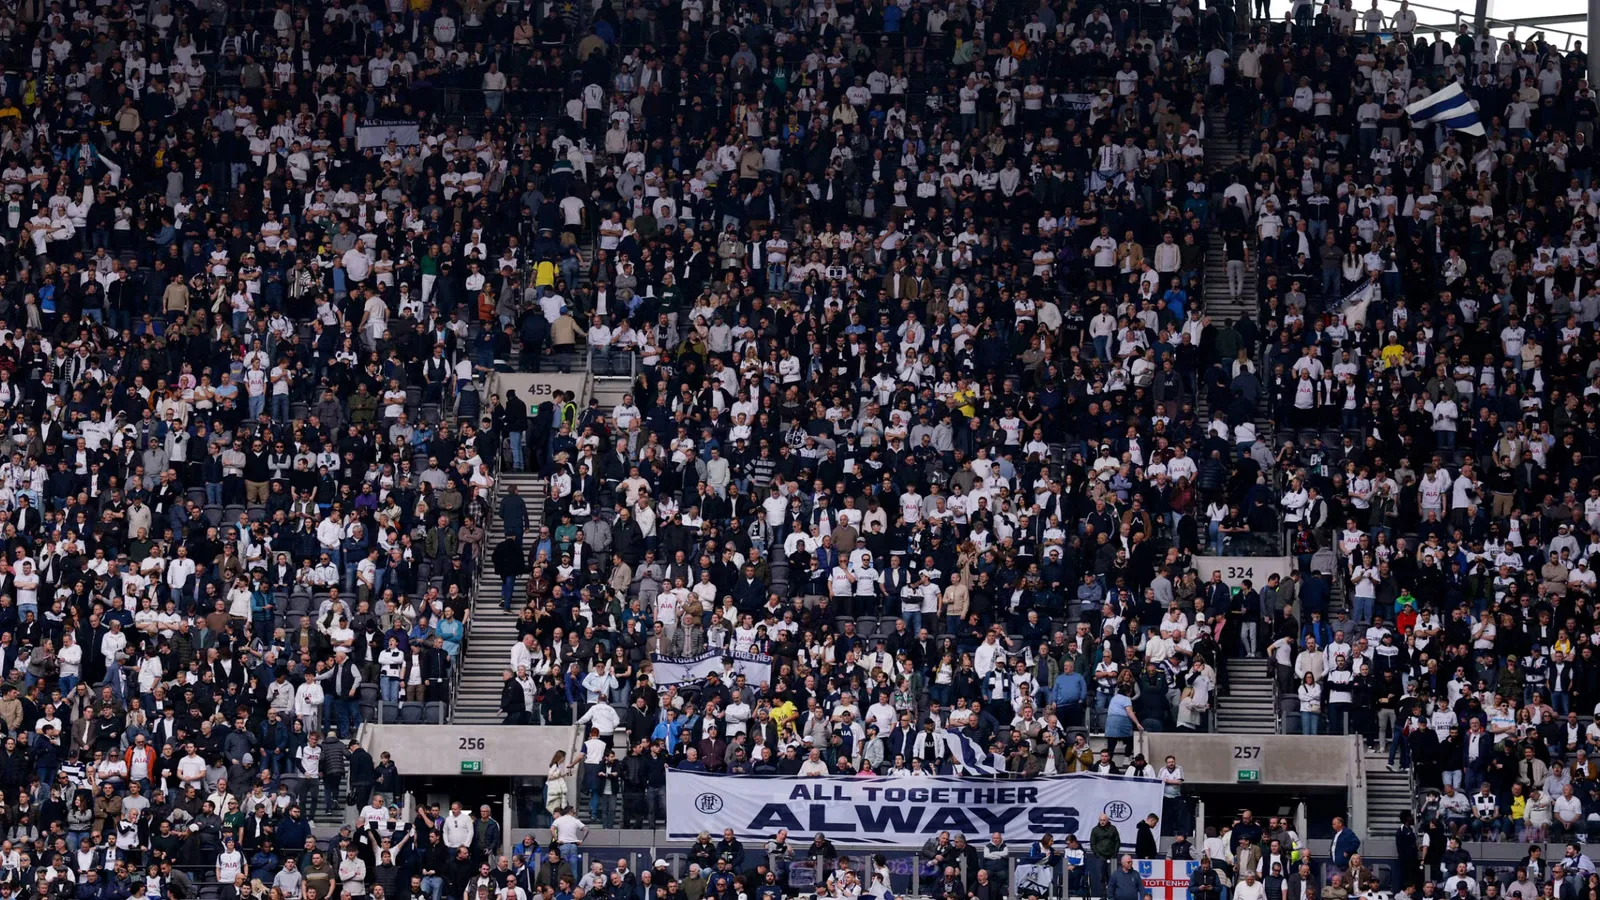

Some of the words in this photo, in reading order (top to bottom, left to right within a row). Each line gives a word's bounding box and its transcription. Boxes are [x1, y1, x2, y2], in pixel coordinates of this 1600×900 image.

[528, 384, 551, 395] 453
[1228, 566, 1253, 578] 324
[674, 649, 715, 664] TOGETHER
[459, 738, 485, 750] 256
[1234, 746, 1260, 758] 257
[789, 784, 852, 801] ALL
[863, 786, 1038, 804] TOGETHER
[746, 803, 1080, 834] ALWAYS
